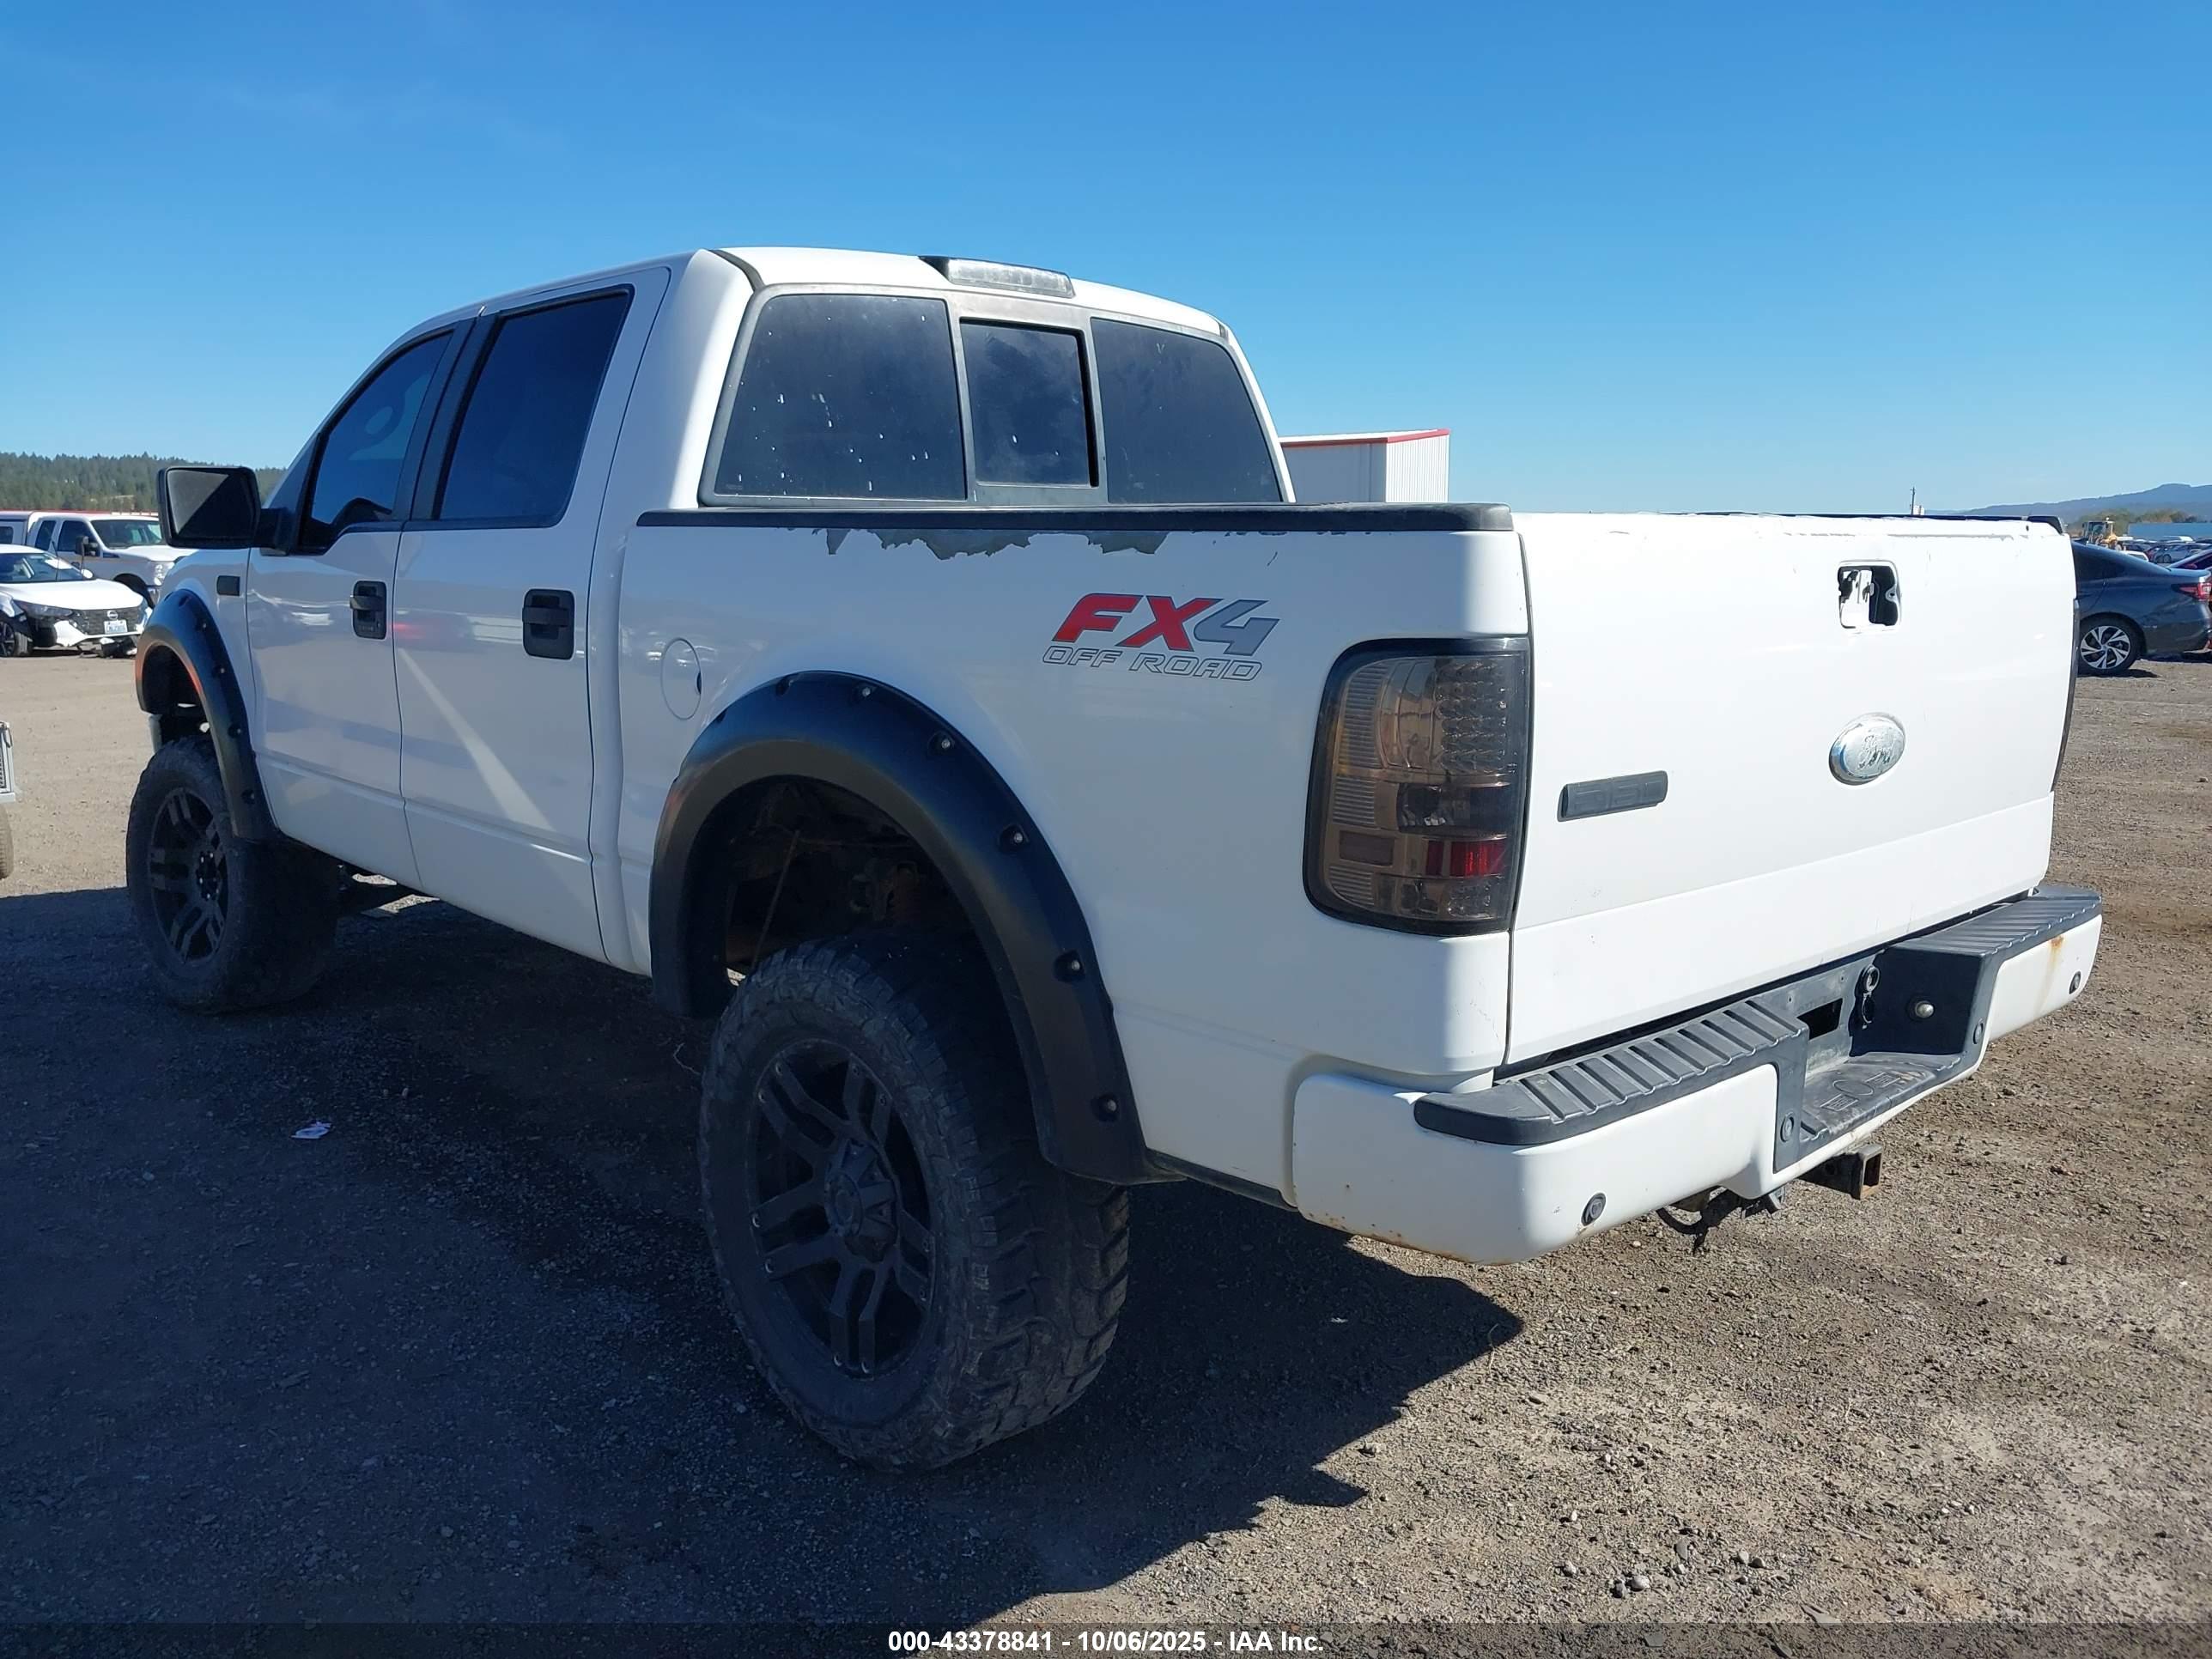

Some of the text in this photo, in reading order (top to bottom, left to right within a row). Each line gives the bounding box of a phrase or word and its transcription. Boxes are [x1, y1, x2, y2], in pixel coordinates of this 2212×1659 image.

[1052, 592, 1280, 657] FX4
[1042, 645, 1263, 682] OFF ROAD
